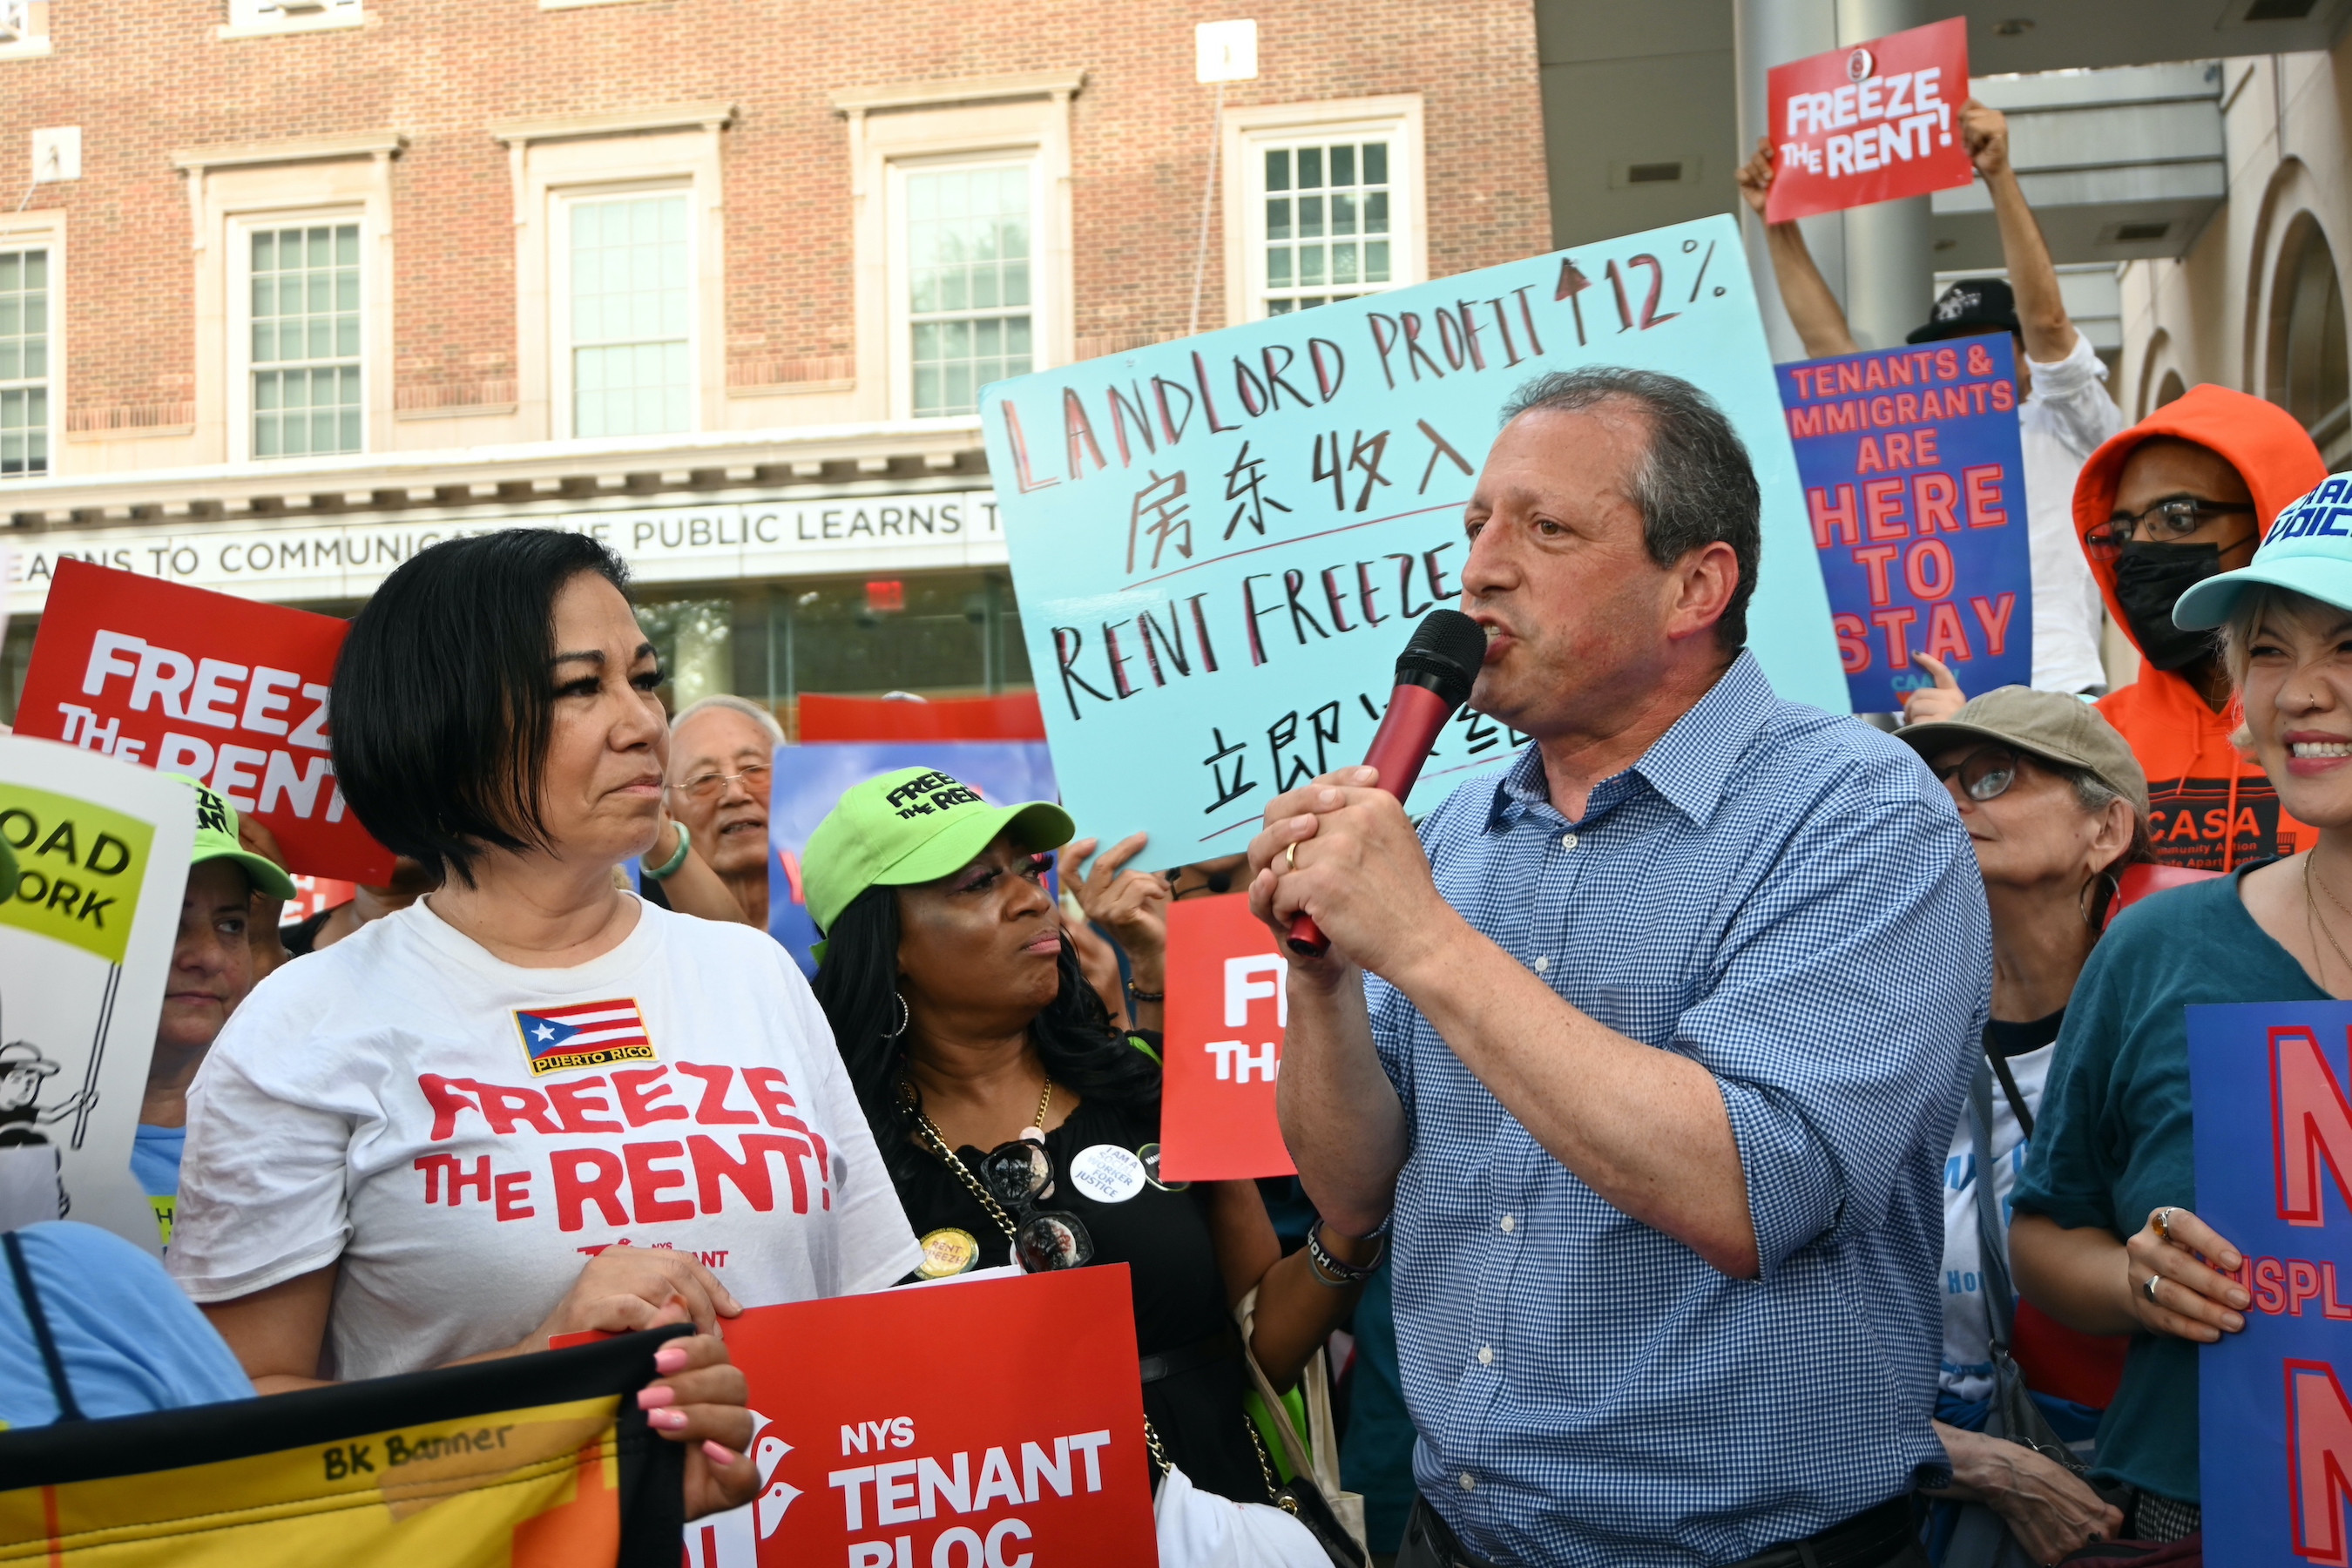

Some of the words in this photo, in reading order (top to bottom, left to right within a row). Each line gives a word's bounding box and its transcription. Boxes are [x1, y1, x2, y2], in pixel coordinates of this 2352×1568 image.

[1788, 66, 1942, 137] FREEZE
[1780, 142, 1822, 174] THE
[1826, 103, 1952, 179] RENT!
[1001, 337, 1345, 494] LANDLORD
[1367, 284, 1544, 389] PROFIT
[1790, 348, 1958, 400] TENANTS
[1965, 342, 1994, 376] &
[1856, 428, 1940, 475] ARE
[1807, 463, 2008, 549] HERE
[2262, 507, 2352, 548] VOIC
[149, 545, 199, 576] TO
[633, 514, 780, 550] PUBLIC
[797, 504, 960, 541] LEARNS
[1852, 537, 1956, 607] TO
[1051, 592, 1219, 721] RENT
[1242, 542, 1463, 667] FREEZE
[1831, 592, 2016, 673] STAY
[896, 802, 936, 820] THE
[2148, 807, 2261, 841] CASA
[535, 1052, 605, 1072] PUERTO
[612, 1046, 652, 1060] RICO
[418, 1061, 812, 1141] FREEZE
[415, 1152, 535, 1222] THE
[551, 1132, 830, 1232] RENT!
[1074, 1170, 1119, 1198] JUSTICE
[1087, 1156, 1133, 1186] WORKER
[1092, 1169, 1115, 1186] FOR
[932, 1240, 963, 1254] RENT
[322, 1444, 375, 1481] BK
[385, 1424, 514, 1467] Banner
[841, 1416, 916, 1456] NYS
[828, 1429, 1112, 1531] TENANT
